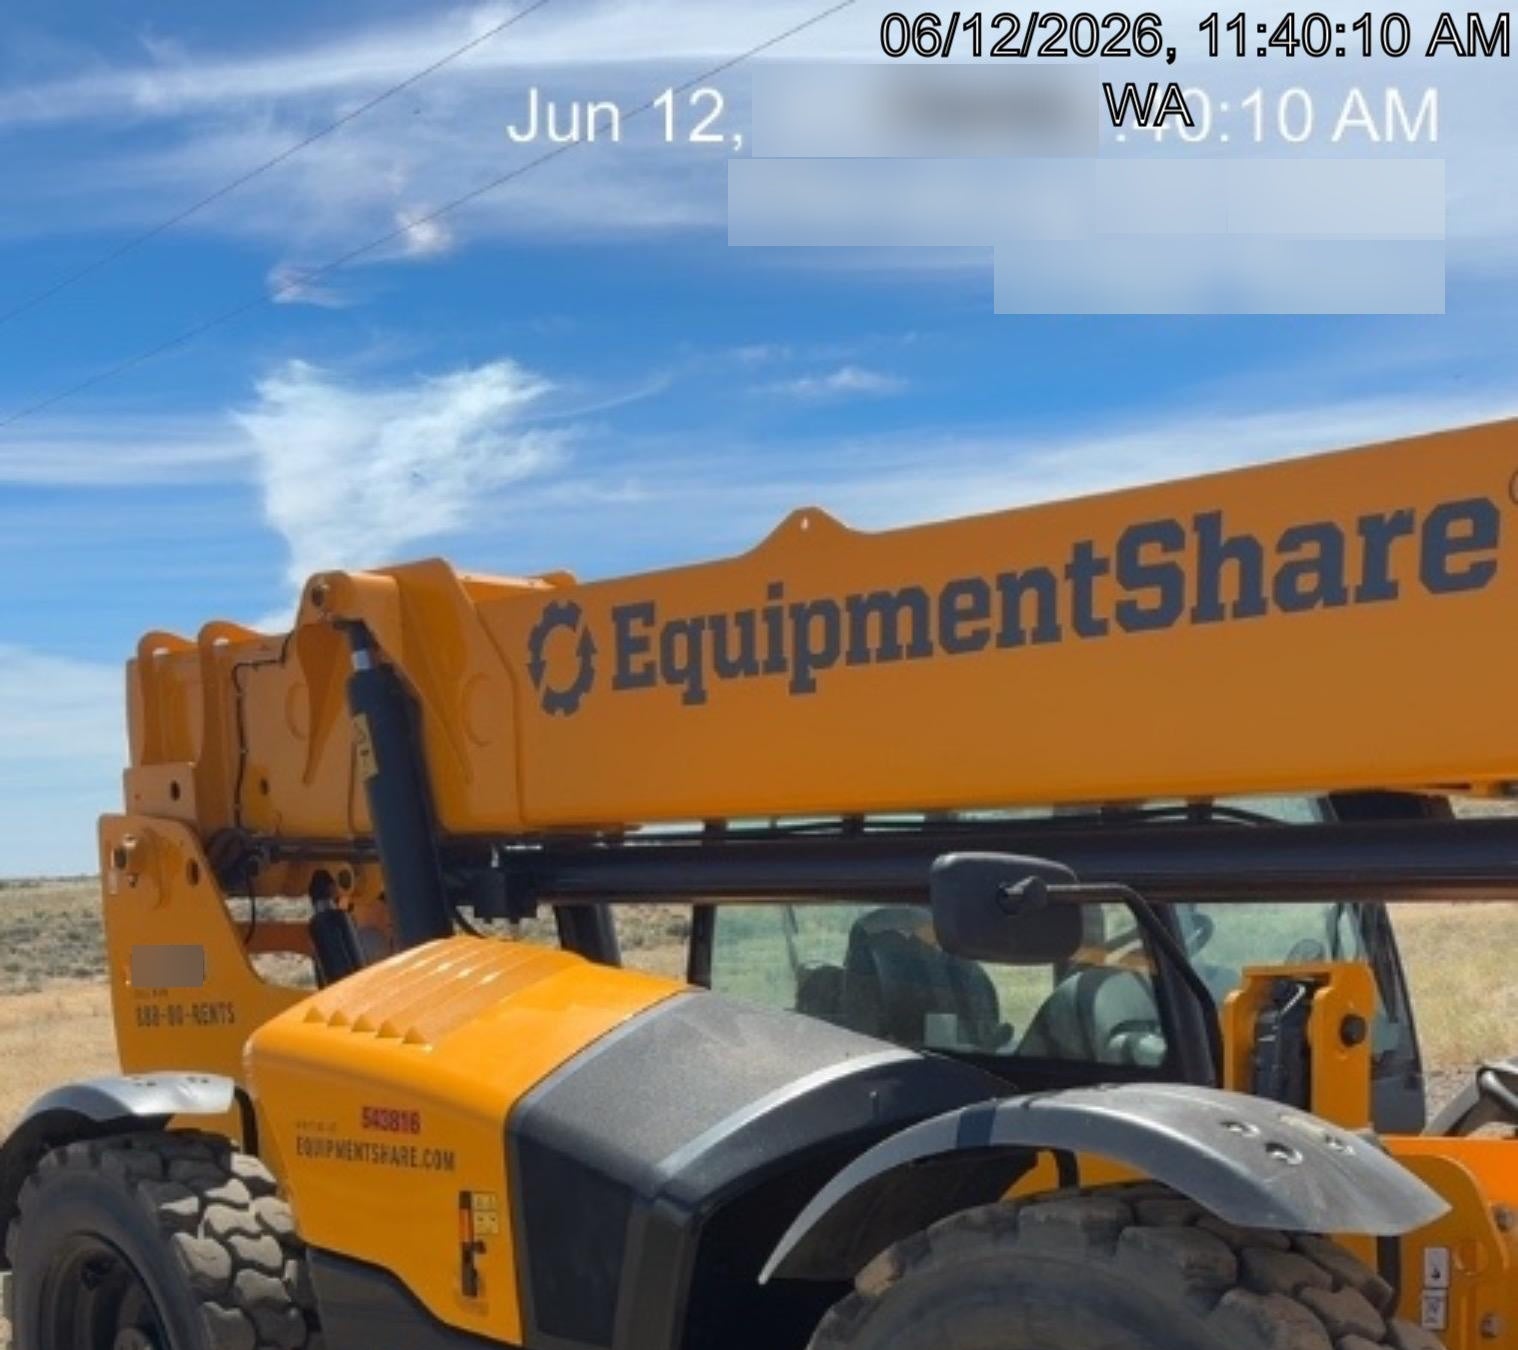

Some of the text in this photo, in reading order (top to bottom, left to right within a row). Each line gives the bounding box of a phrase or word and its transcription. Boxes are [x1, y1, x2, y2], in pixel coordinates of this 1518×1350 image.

[611, 496, 1500, 706] EquipmentShare
[362, 1106, 421, 1135] 543816
[296, 1136, 456, 1171] EQUIPMENTSHARE.COM
